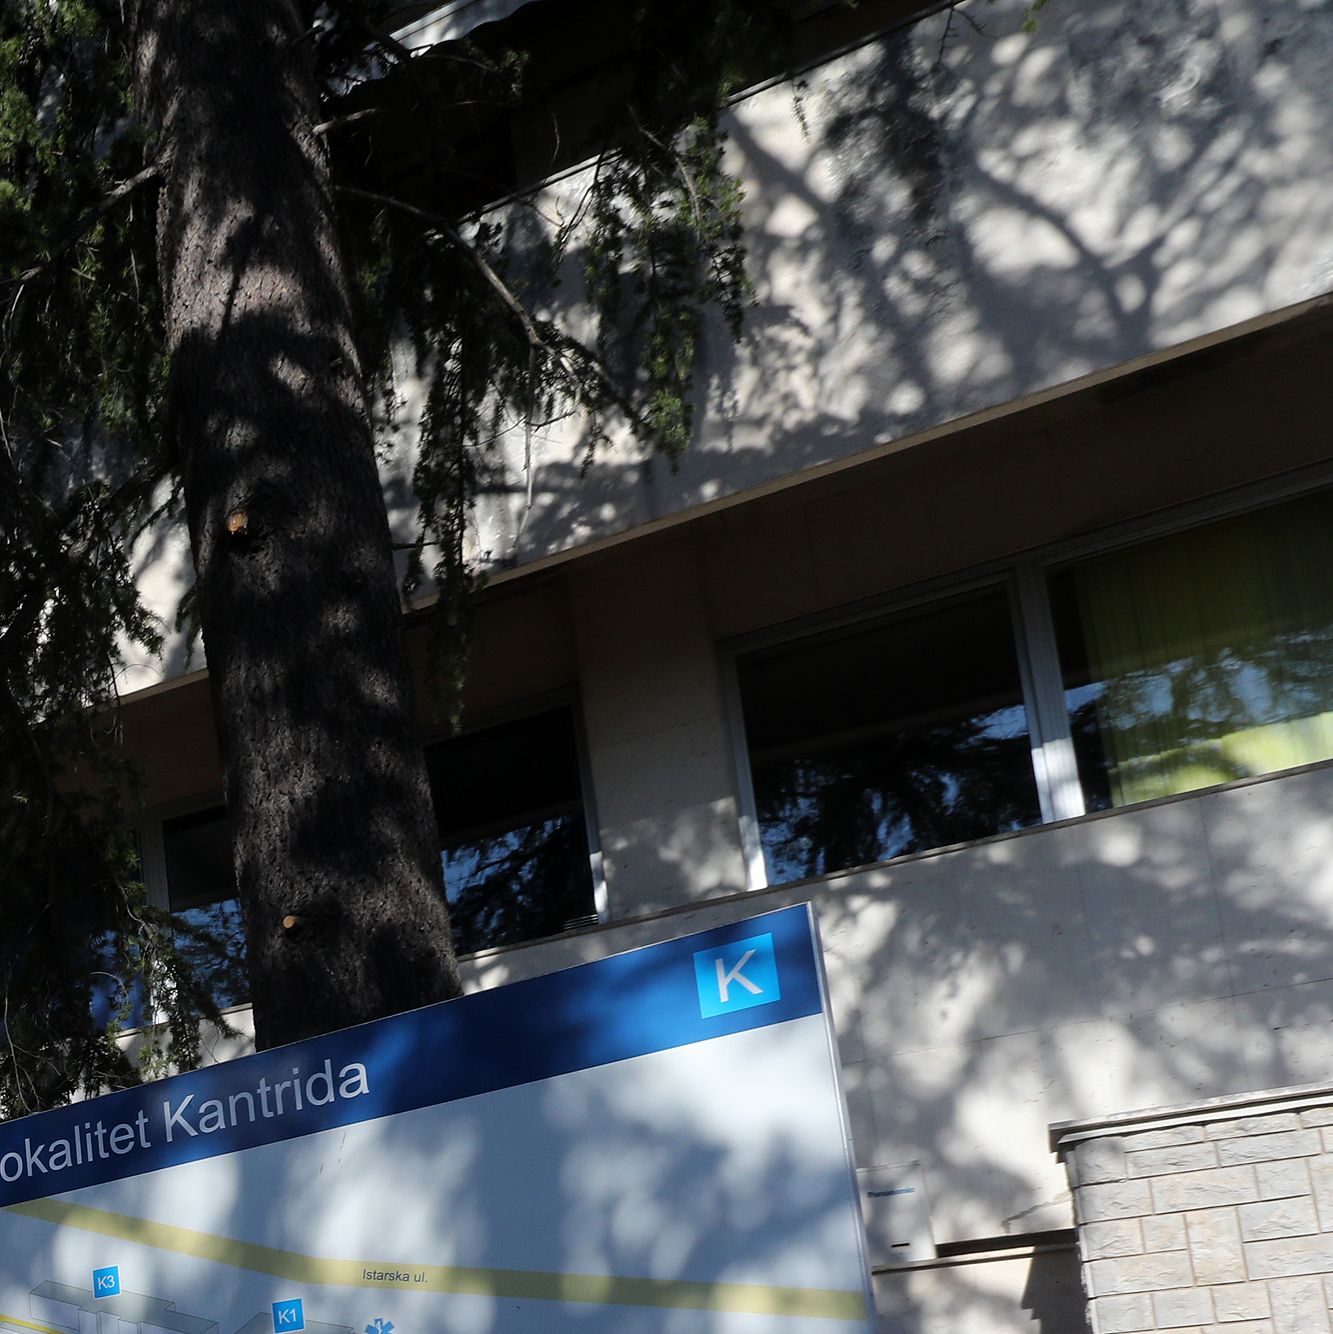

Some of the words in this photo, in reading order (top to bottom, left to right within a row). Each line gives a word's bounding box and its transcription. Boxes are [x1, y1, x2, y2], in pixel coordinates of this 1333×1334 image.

[715, 949, 764, 1003] K
[163, 1059, 370, 1143] Kantrida
[97, 1276, 116, 1289] K3
[363, 1269, 409, 1282] Istarska
[413, 1271, 428, 1283] ul.
[279, 1308, 296, 1324] K1
